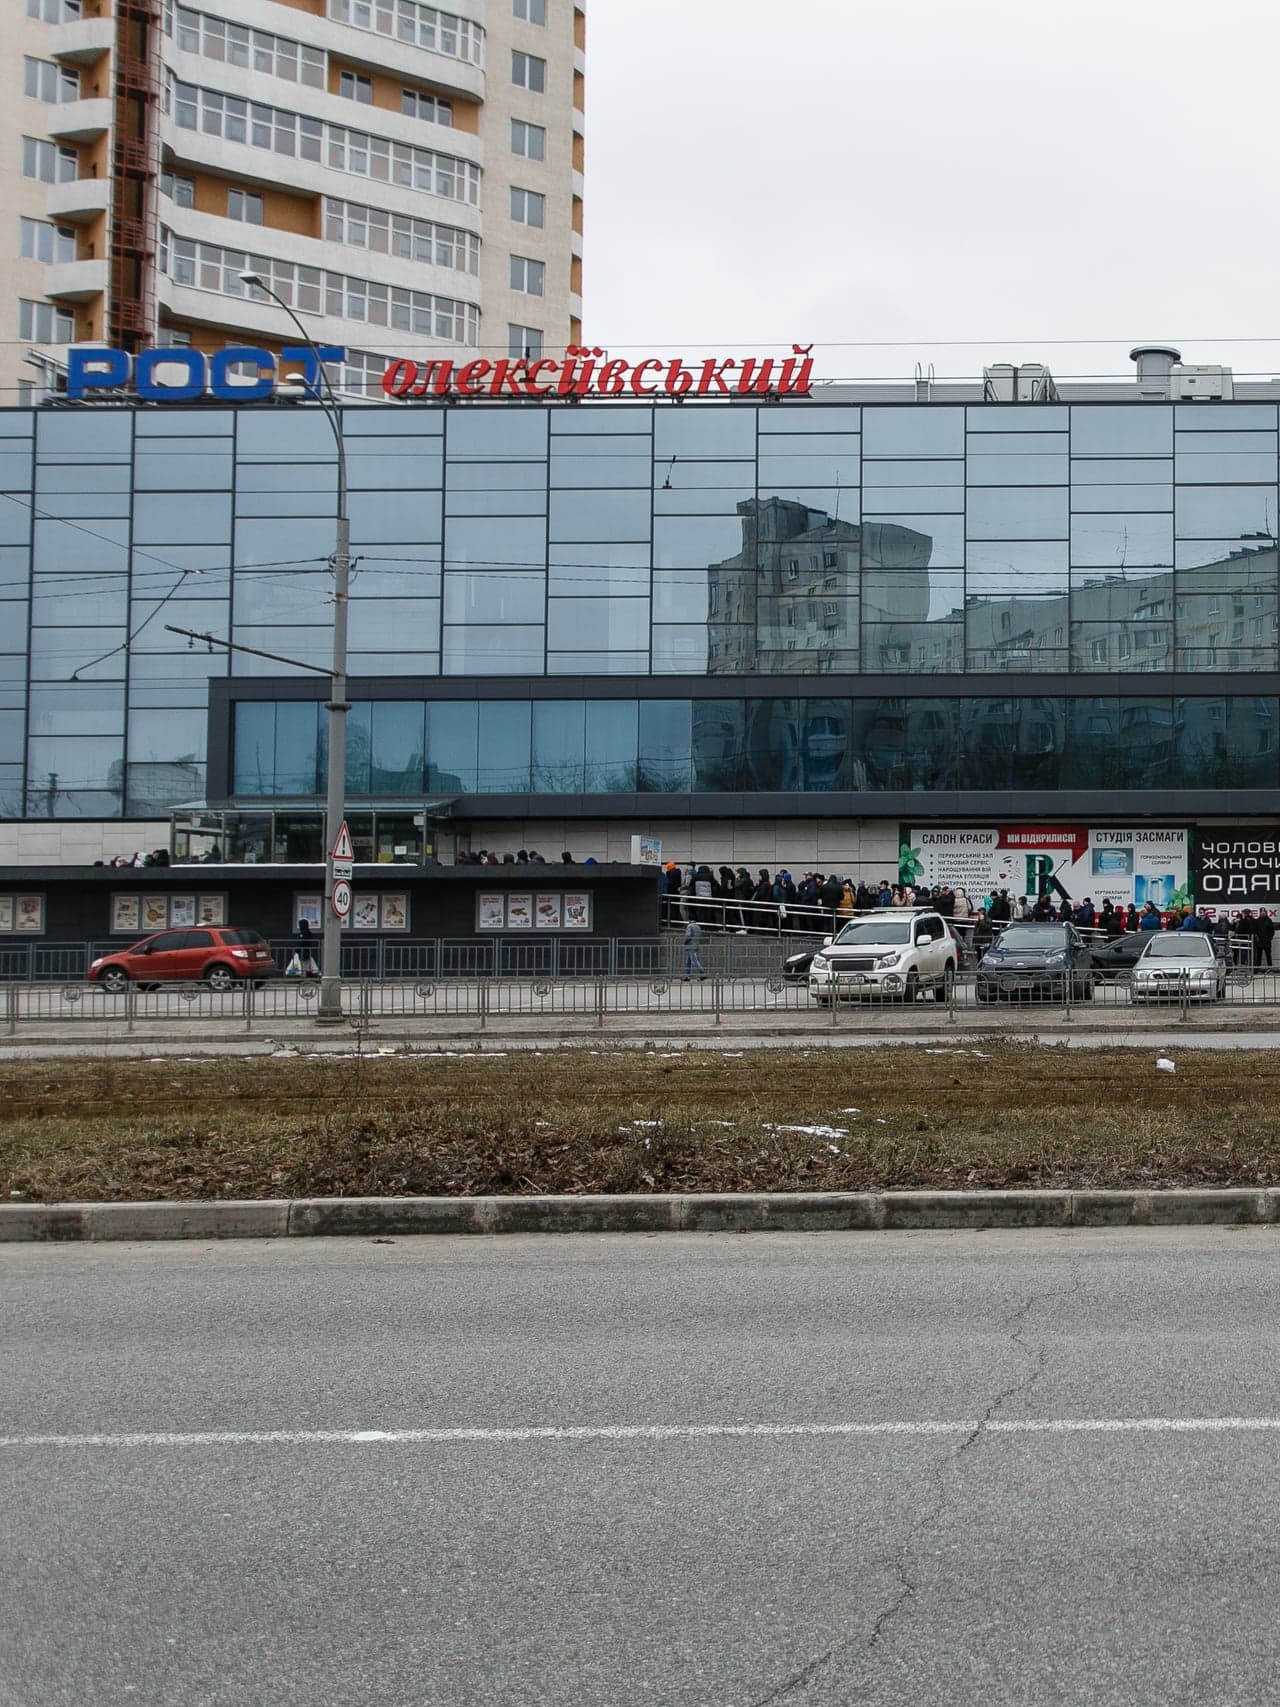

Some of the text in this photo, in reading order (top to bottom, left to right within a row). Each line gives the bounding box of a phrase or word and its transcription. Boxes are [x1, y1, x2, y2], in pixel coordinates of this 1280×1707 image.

[68, 346, 347, 400] РОСТ
[381, 344, 814, 395] олексіївський
[922, 833, 993, 844] САЛОН КРАСИ
[1096, 831, 1184, 844] СТУДІЯ ЗАСМАГИ
[336, 892, 349, 906] 40
[1204, 907, 1217, 918] 2
